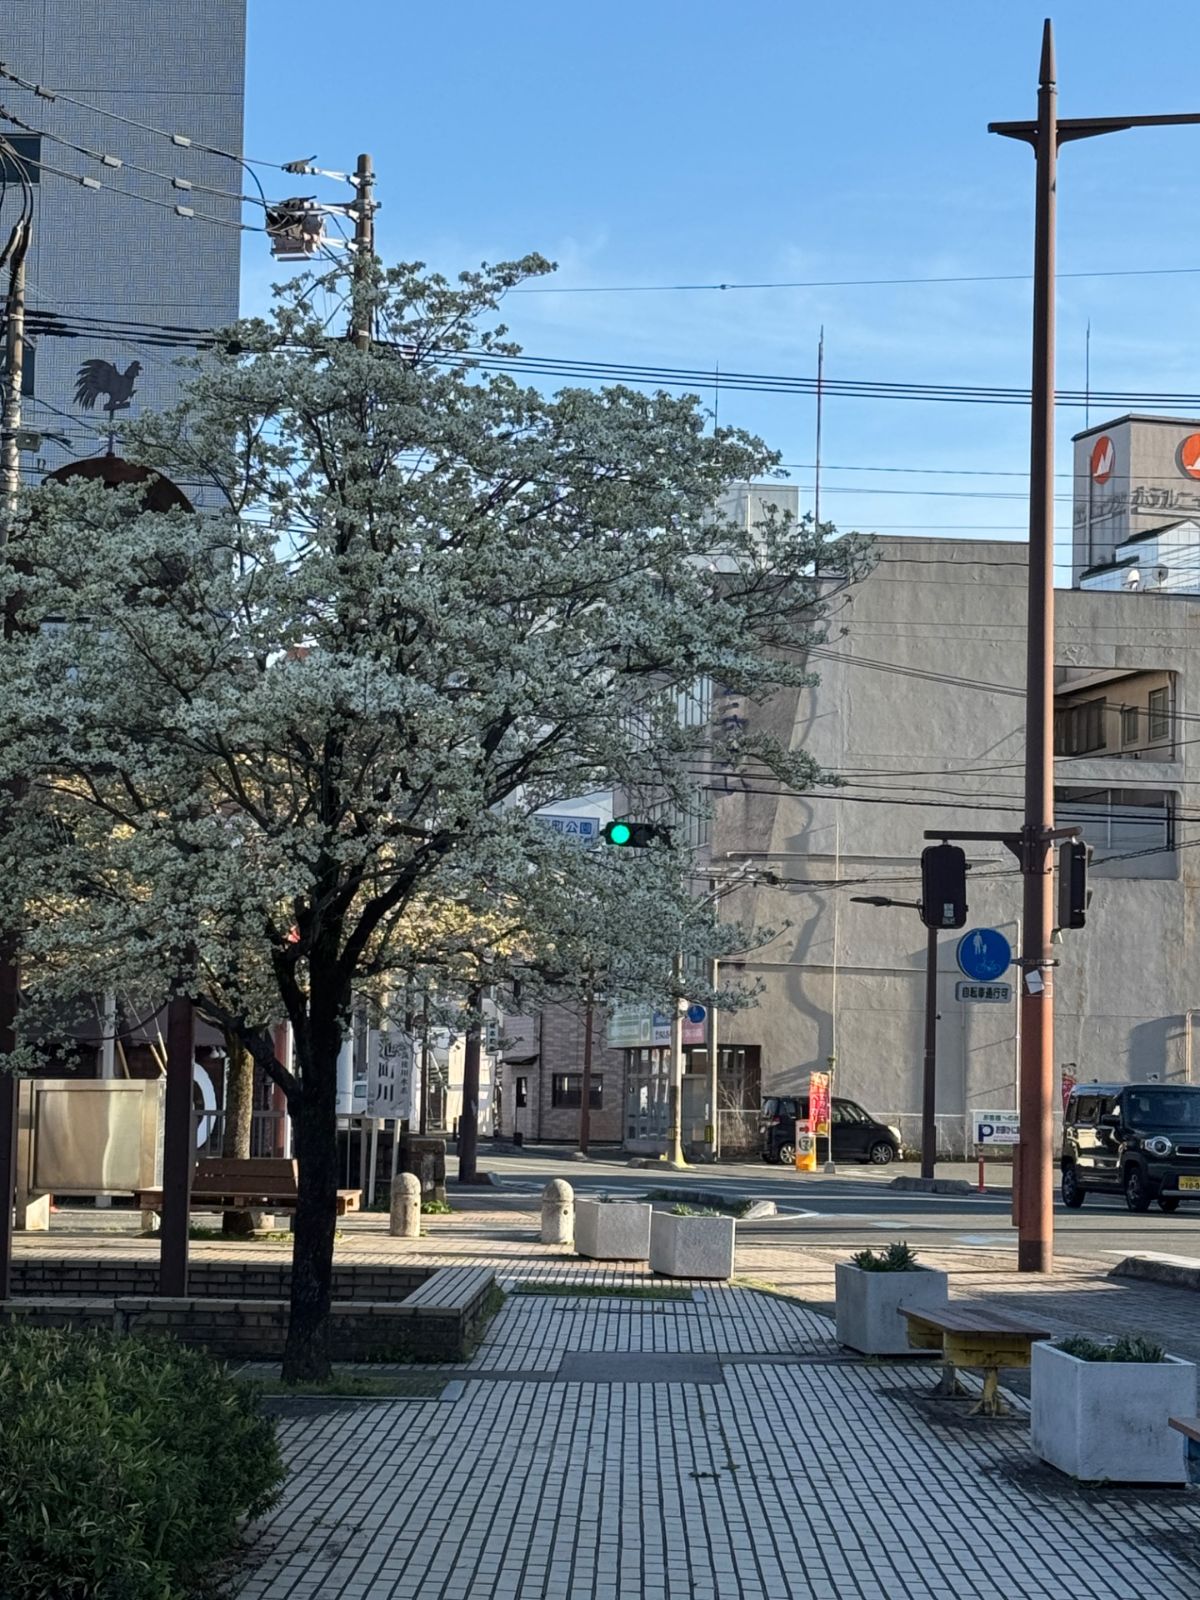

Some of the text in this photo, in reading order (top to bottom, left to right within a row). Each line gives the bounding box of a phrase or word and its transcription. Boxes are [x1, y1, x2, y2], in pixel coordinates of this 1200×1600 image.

[538, 818, 592, 835] 町公園
[962, 986, 1008, 1000] 自転車通行可
[978, 1123, 994, 1142] P
